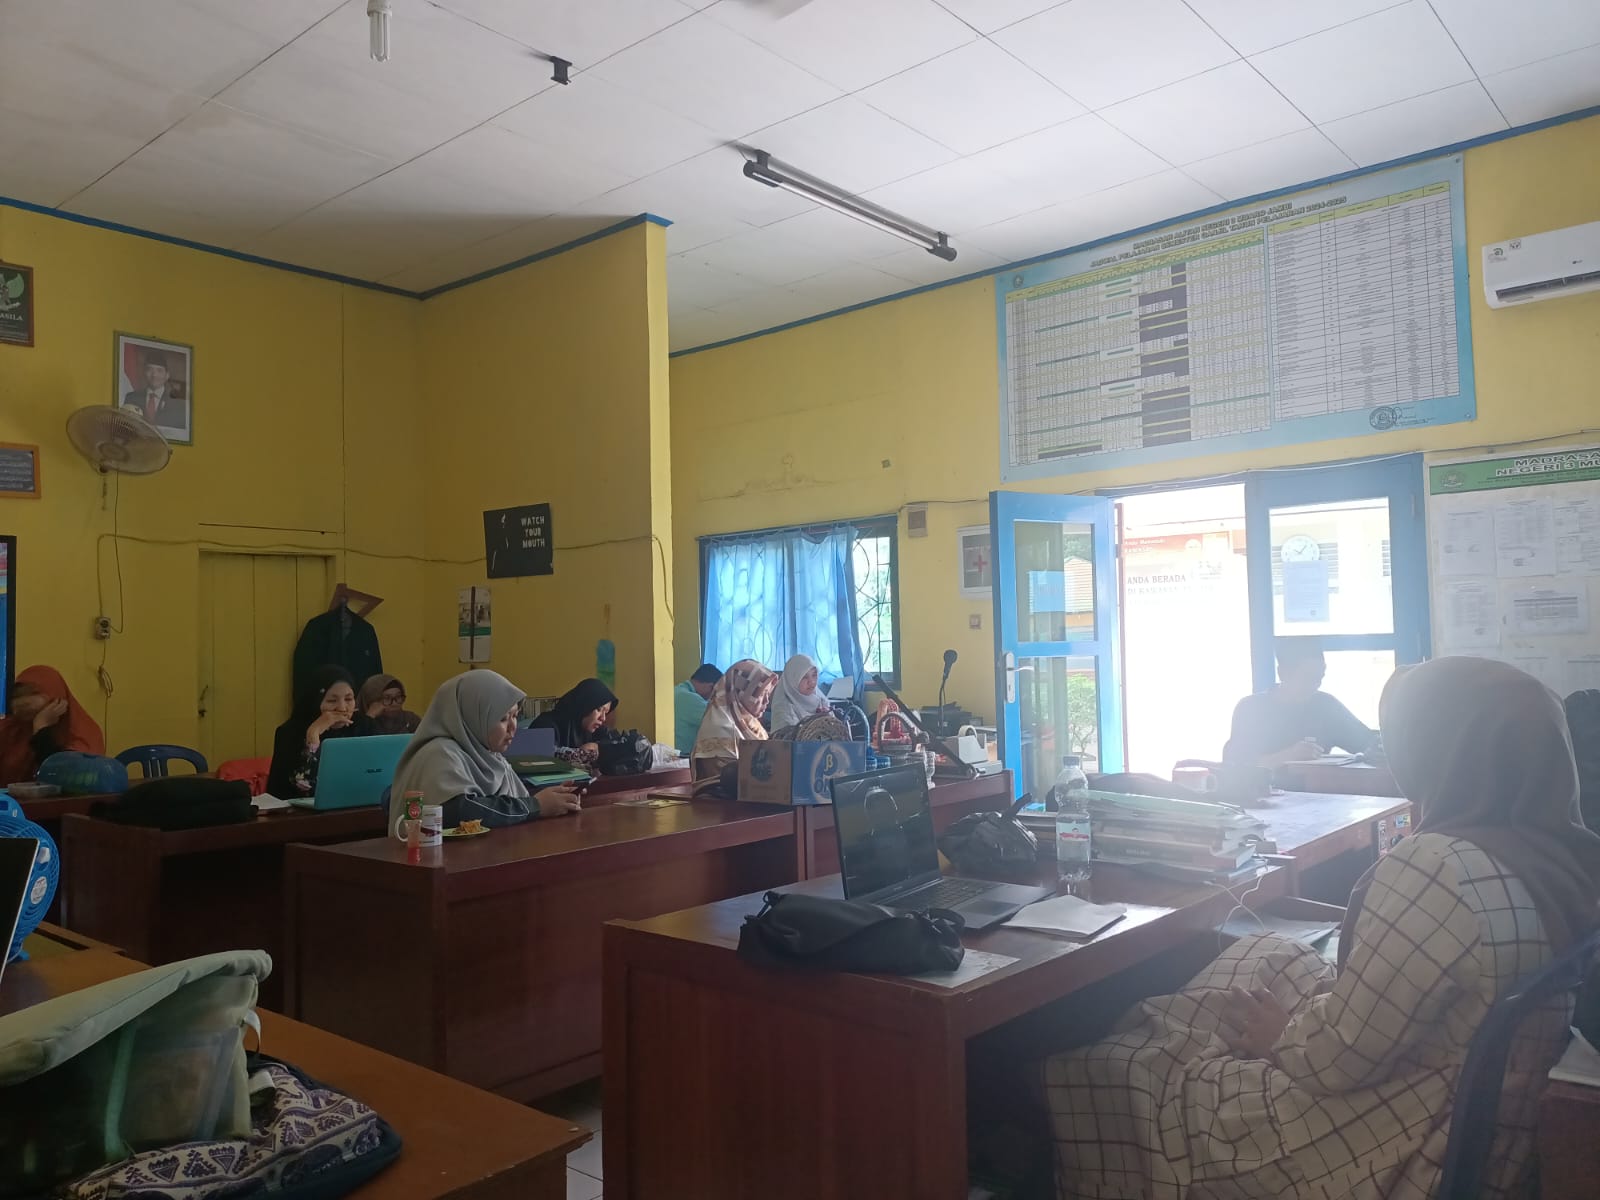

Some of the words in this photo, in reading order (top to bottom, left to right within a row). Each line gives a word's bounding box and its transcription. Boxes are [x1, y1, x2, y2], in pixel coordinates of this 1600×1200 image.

[1496, 463, 1560, 477] NEGERI
[1564, 461, 1575, 470] 3
[520, 515, 545, 527] WATCH
[524, 527, 542, 537] YOUR
[522, 538, 545, 549] MOUTH
[1127, 576, 1149, 585] ANDA
[1152, 574, 1187, 584] BERADA
